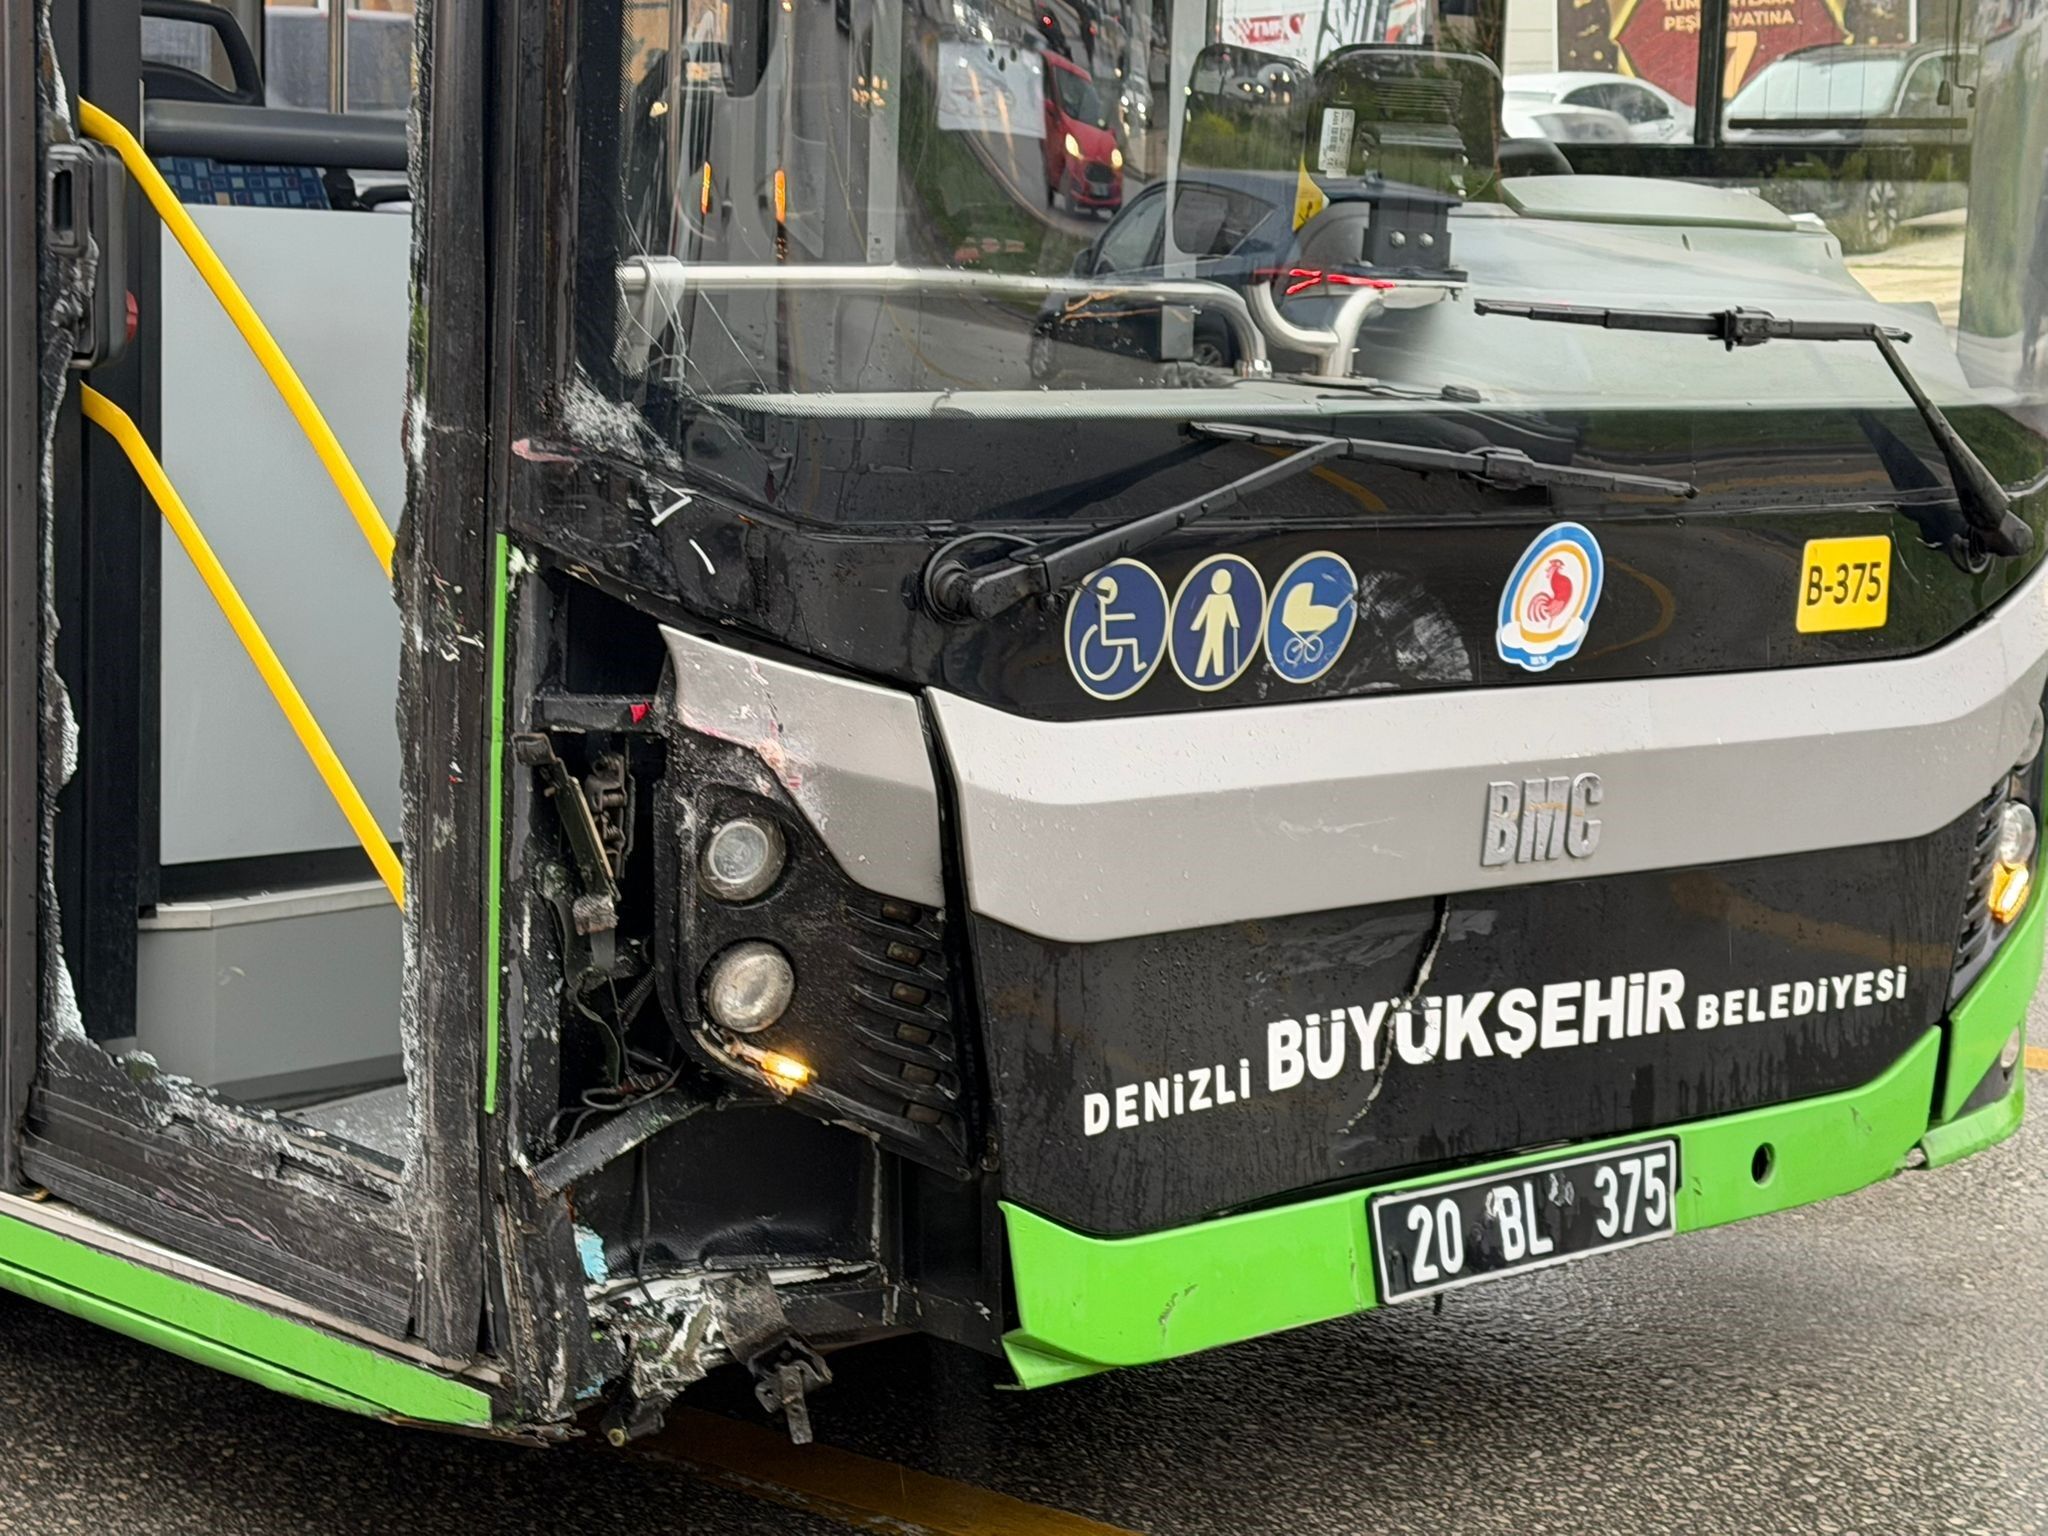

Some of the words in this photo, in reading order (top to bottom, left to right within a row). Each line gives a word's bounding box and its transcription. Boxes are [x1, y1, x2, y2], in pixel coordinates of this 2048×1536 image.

[1722, 31, 1757, 99] 7
[1806, 561, 1882, 606] B-375
[1480, 772, 1602, 867] BMC
[1083, 1058, 1251, 1136] DENİZLİ
[1267, 968, 1686, 1092] BÜYÜKŞEHİR
[1696, 965, 1908, 1030] BELEDİYESİ
[1407, 1198, 1464, 1283] 20
[1492, 1181, 1553, 1261] BL
[1594, 1153, 1667, 1239] 375
